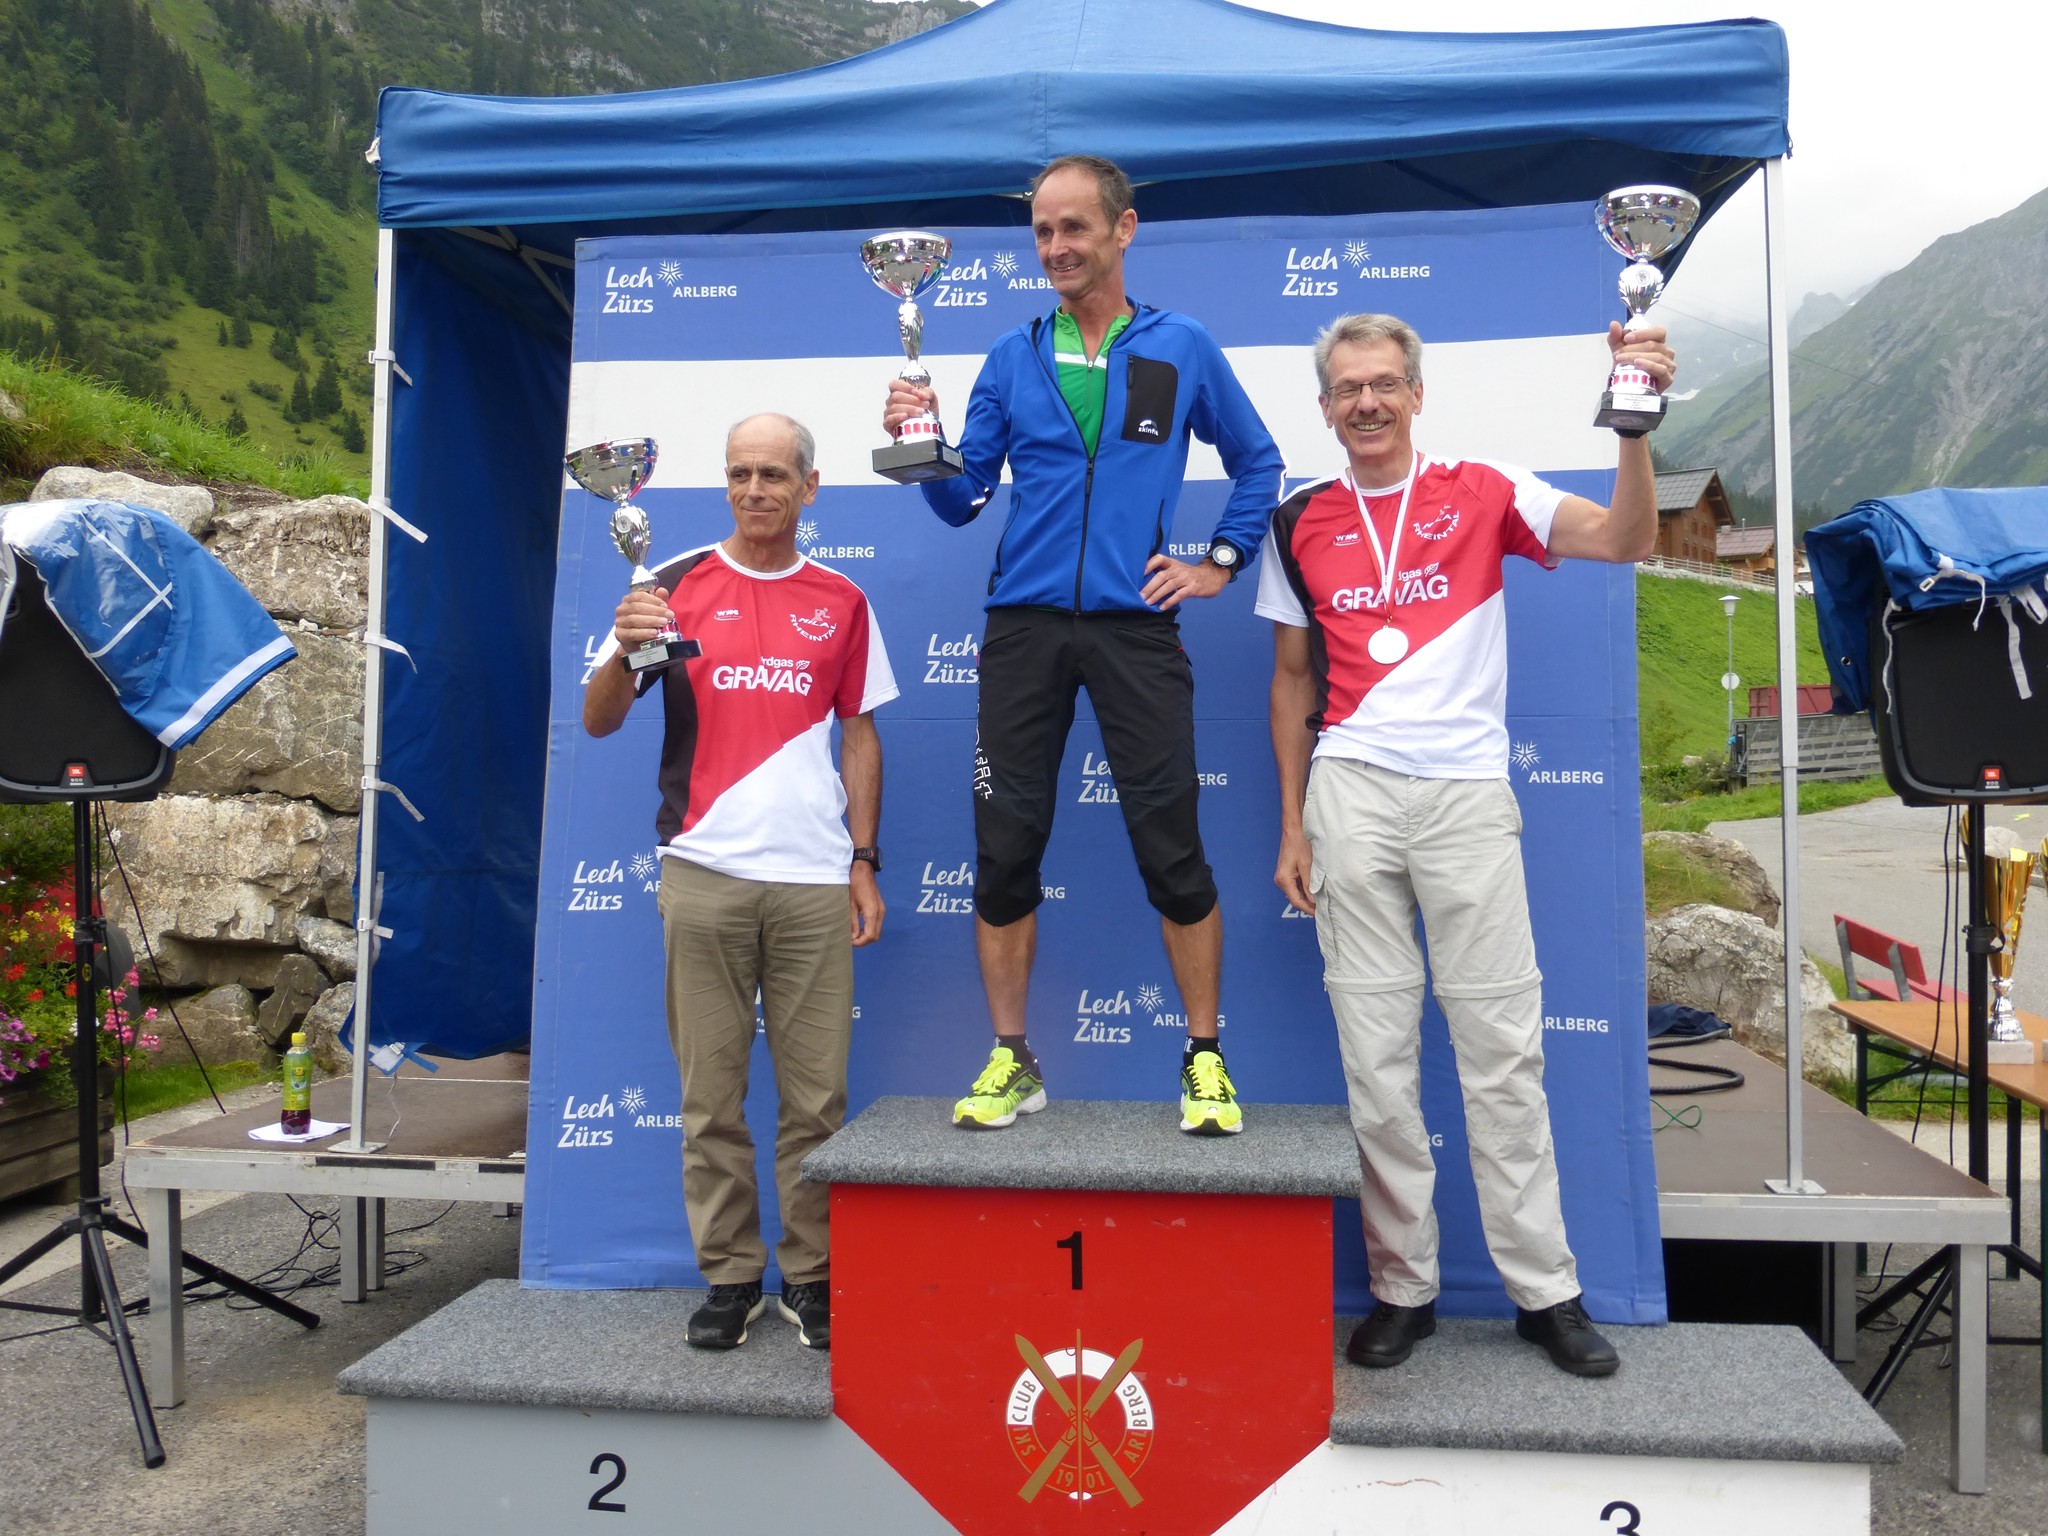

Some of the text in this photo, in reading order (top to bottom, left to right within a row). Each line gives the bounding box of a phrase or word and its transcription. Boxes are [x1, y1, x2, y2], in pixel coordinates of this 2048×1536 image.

[1286, 247, 1338, 270] Lech
[606, 266, 654, 288] Lech
[1007, 277, 1055, 290] ARLBE
[1282, 273, 1339, 296] Zürs
[1359, 266, 1431, 279] ARLBERG
[602, 291, 654, 313] Zürs
[672, 285, 737, 298] ARLBERG
[933, 284, 988, 307] Zürs
[808, 546, 875, 558] ARLBERG
[1168, 543, 1212, 556] RLBE
[790, 613, 838, 642] RHEINTAL
[927, 633, 978, 657] Lech
[760, 655, 794, 669] rdgas
[923, 660, 979, 684] Zürs
[712, 664, 813, 697] GRAVAG
[1082, 752, 1112, 776] Le
[1528, 770, 1604, 784] ARLBERG
[573, 859, 624, 884] Lech
[922, 862, 974, 886] Lech
[567, 887, 623, 911] Zürs
[916, 889, 973, 914] Zürs
[1077, 989, 1131, 1015] Lech
[1073, 1018, 1132, 1043] Zürs
[1153, 1013, 1226, 1028] ARLG
[1541, 1016, 1609, 1033] RLBERG
[563, 1094, 615, 1120] Lech
[634, 1115, 683, 1128] ARLBE
[557, 1123, 613, 1148] Zürs
[1056, 1230, 1083, 1291] 1
[1011, 1380, 1037, 1423] CLUB
[1012, 1427, 1037, 1457] SKI
[588, 1452, 627, 1513] 2
[1599, 1500, 1642, 1536] 3
